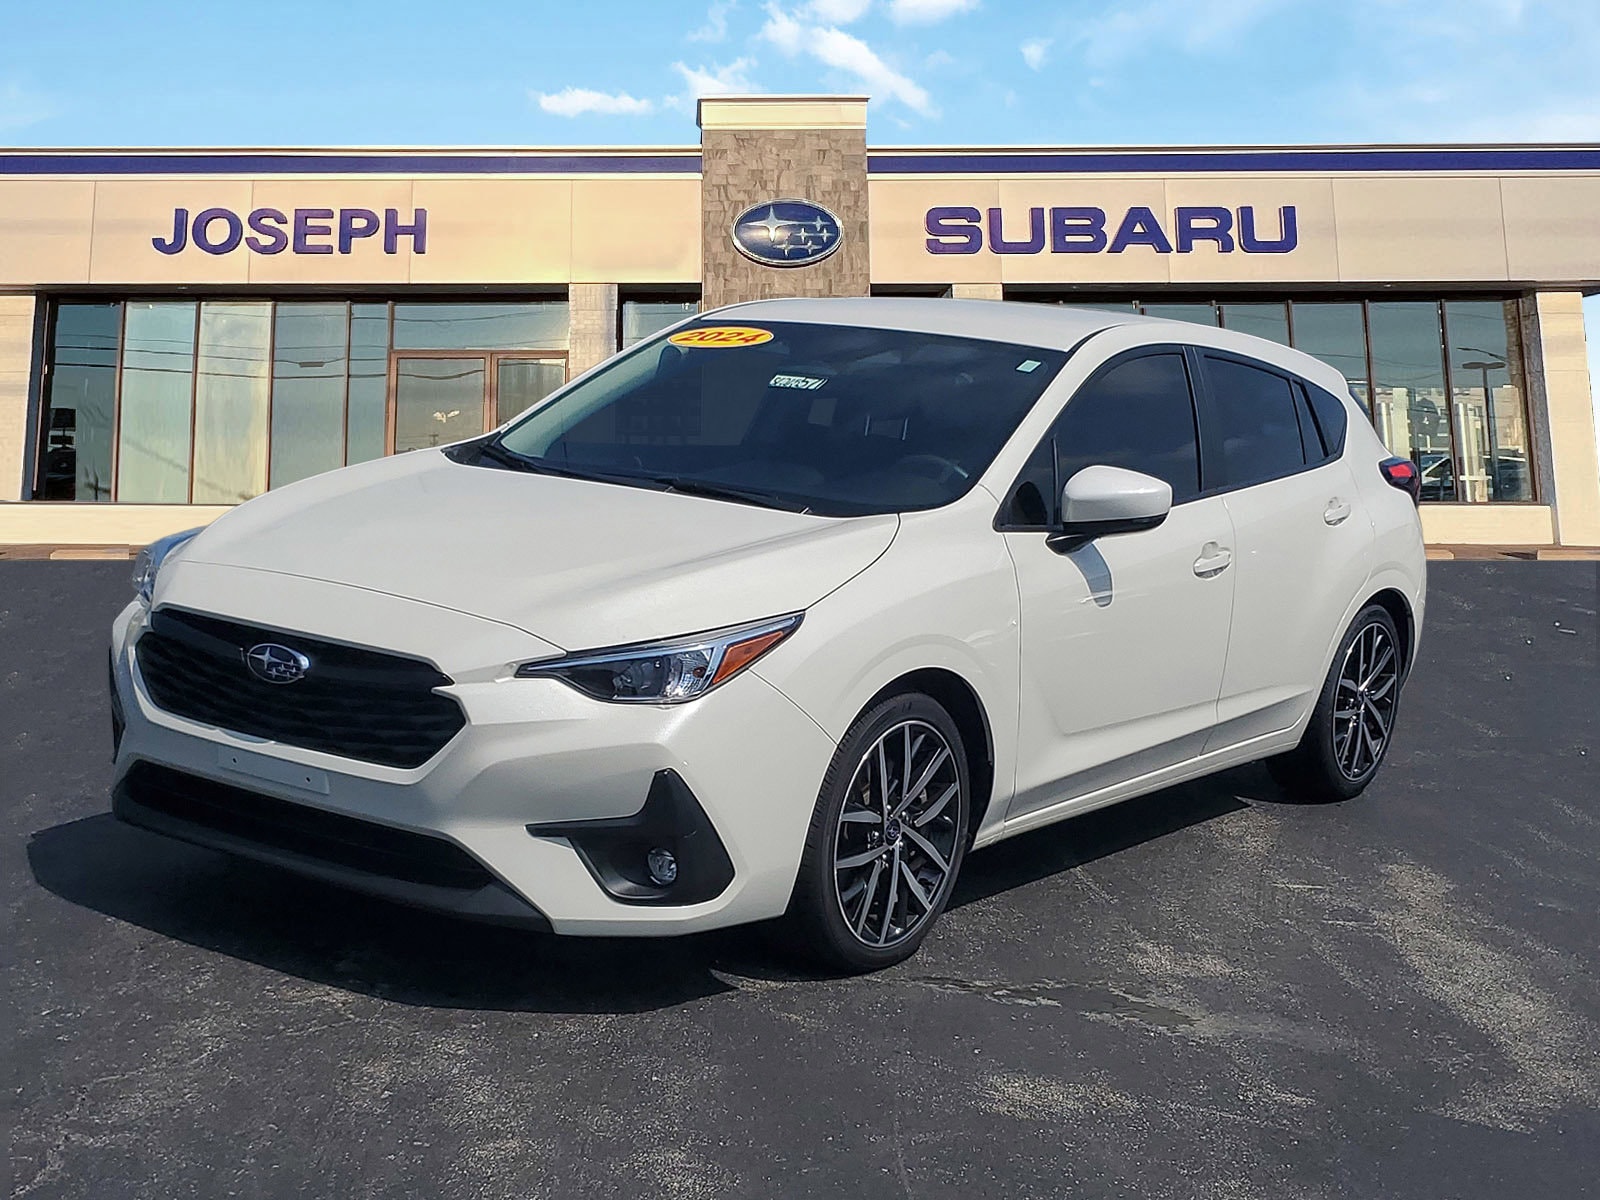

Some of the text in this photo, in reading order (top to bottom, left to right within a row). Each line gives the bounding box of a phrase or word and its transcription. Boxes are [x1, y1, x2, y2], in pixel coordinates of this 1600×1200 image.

[152, 208, 427, 255] JOSEPH
[925, 206, 1297, 254] SUBARU
[676, 330, 766, 343] 2024
